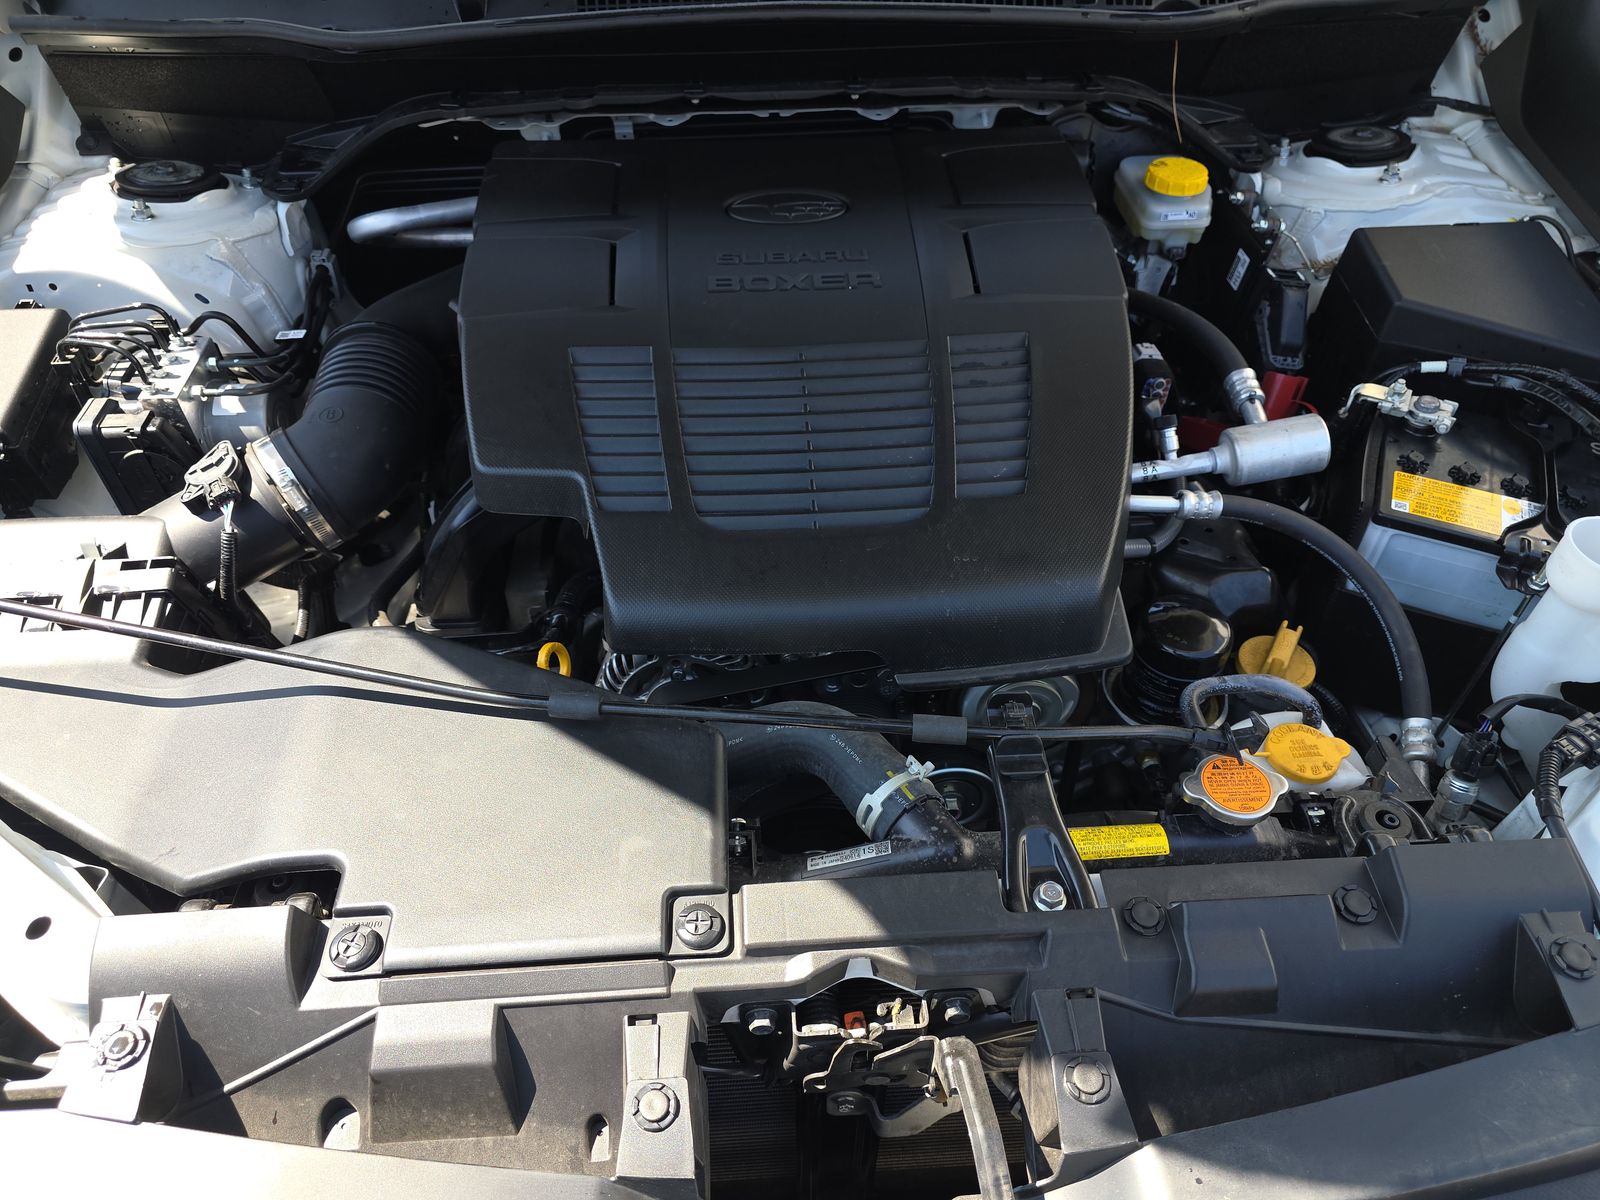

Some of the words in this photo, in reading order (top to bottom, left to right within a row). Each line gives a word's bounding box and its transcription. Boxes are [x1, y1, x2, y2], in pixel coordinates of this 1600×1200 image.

[716, 249, 869, 265] SUBARU
[707, 272, 882, 293] BOXER
[1270, 725, 1326, 744] COOLANT
